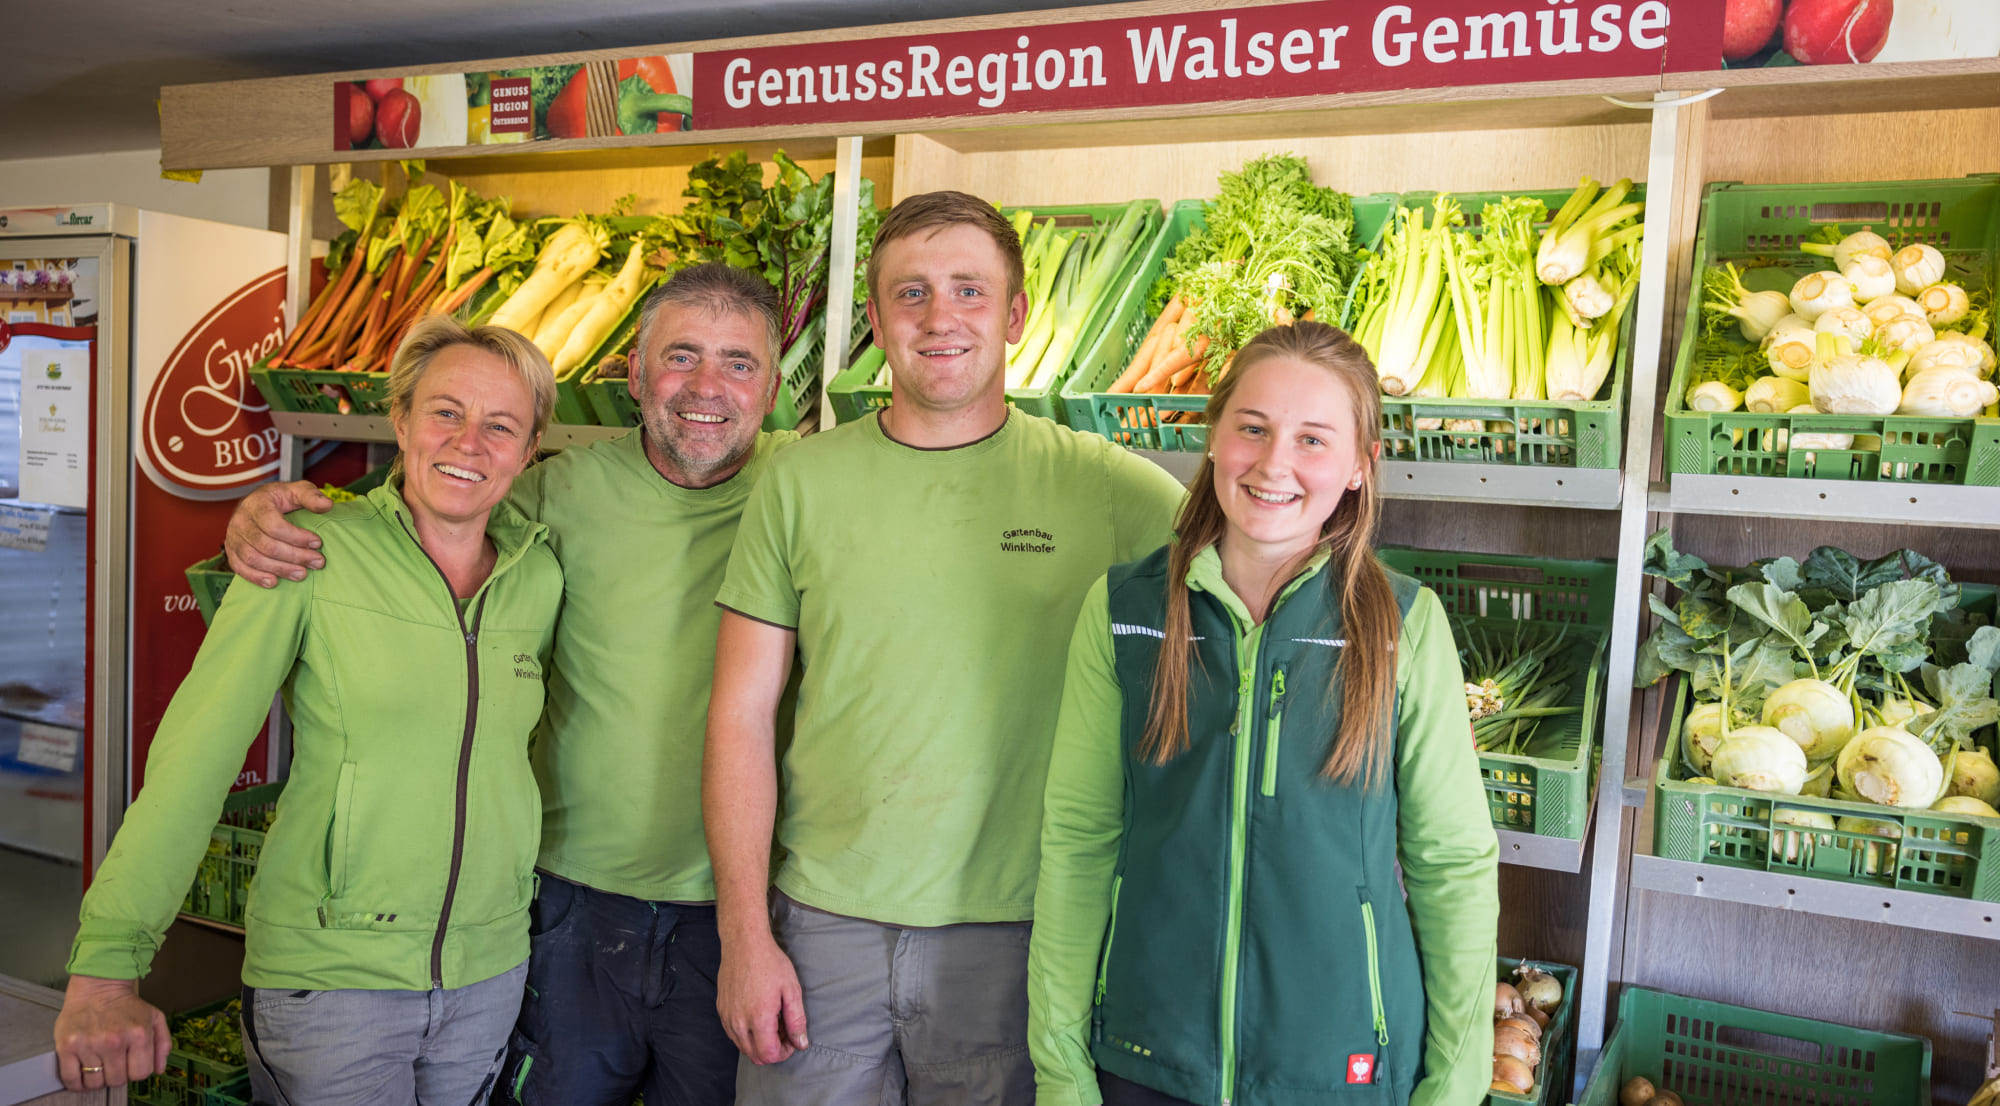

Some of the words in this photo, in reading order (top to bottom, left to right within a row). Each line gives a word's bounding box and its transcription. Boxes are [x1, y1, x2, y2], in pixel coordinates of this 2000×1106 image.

[723, 35, 1107, 109] GenussRegion
[1126, 19, 1349, 85] Walser
[1371, 0, 1671, 68] Gemüse
[493, 86, 529, 98] GENUSS
[493, 101, 529, 112] REGION
[1002, 528, 1053, 541] Gartenbau
[1000, 542, 1056, 553] Winklhofer
